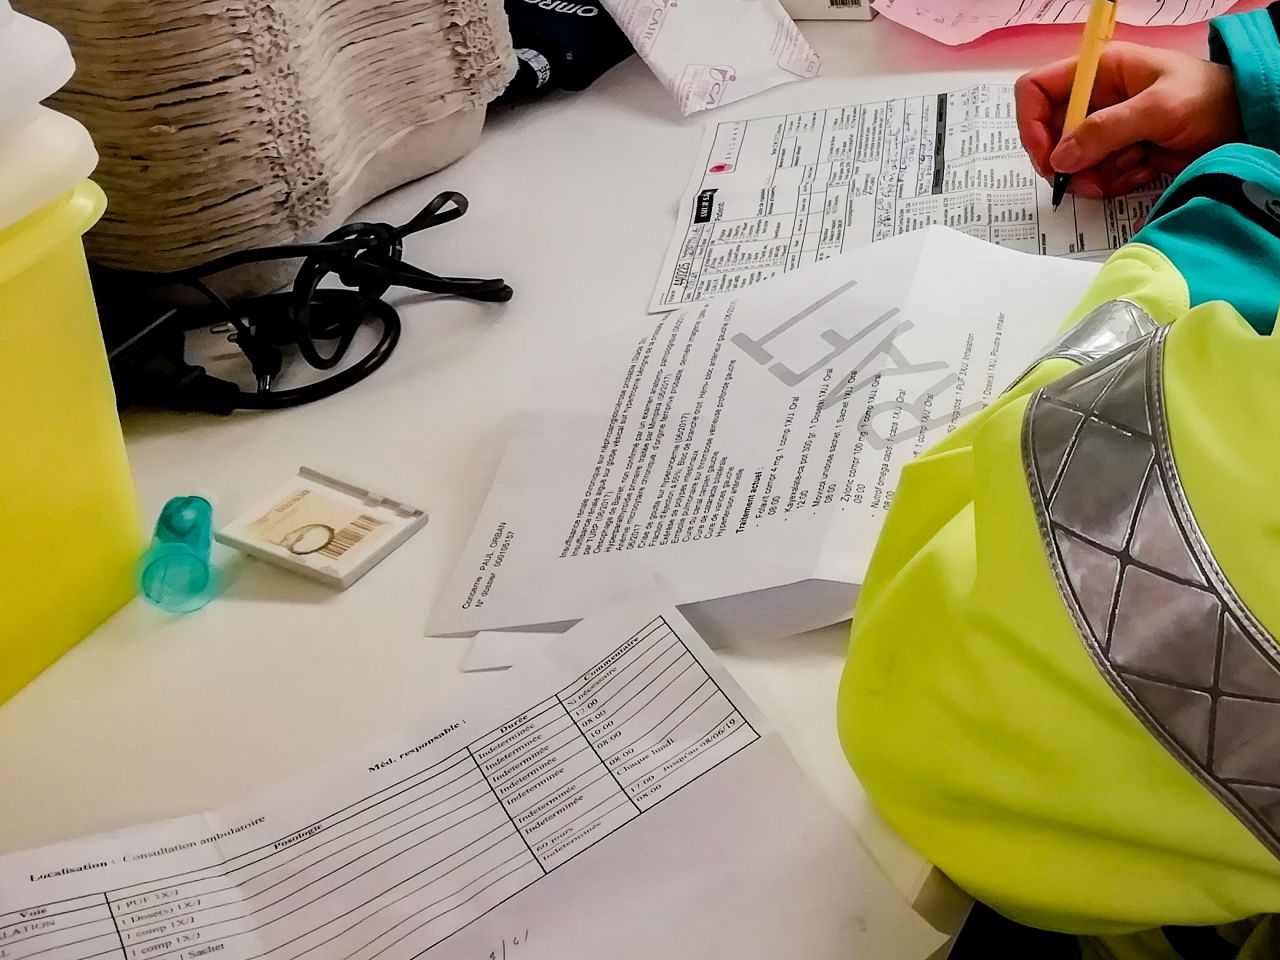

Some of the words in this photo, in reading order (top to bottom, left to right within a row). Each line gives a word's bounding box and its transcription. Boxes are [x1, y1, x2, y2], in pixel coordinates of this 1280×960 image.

[643, 8, 662, 40] CAIR
[963, 333, 974, 361] Inhalation
[990, 337, 1001, 356] Poudre
[730, 280, 988, 450] RAFT
[823, 368, 833, 382] Oral
[871, 373, 881, 387] Oral
[863, 405, 874, 422] comp
[802, 440, 812, 455] 300
[812, 480, 826, 507] Movicol
[822, 453, 834, 479] unidose
[837, 399, 849, 422] Sachet
[848, 370, 858, 384] Oral
[853, 442, 863, 455] 100
[870, 486, 882, 509] Nutrof
[877, 463, 889, 486] omega
[889, 421, 898, 438] caps
[896, 389, 906, 404] Oral
[671, 516, 686, 544] Embolie
[681, 482, 698, 516] pulmonaire
[693, 471, 701, 481] sur
[697, 437, 713, 470] thrombose
[709, 407, 721, 436] veineuse
[717, 382, 730, 408] profonde
[725, 359, 737, 381] gauche
[755, 495, 769, 519] Folavit
[764, 473, 776, 494] compr
[779, 427, 790, 446] comp
[789, 396, 800, 410] Oral
[800, 454, 808, 464] pot
[683, 450, 699, 482] intestinaux
[848, 454, 859, 478] compr
[674, 484, 687, 508] polypes
[704, 523, 716, 539] Cure
[711, 513, 719, 522] de
[715, 488, 727, 511] varices
[722, 466, 735, 489] gauche
[736, 492, 755, 534] Traitement
[750, 471, 762, 493] actuel
[840, 479, 854, 502] Zyloric
[671, 509, 678, 517] de
[716, 496, 734, 537] Hypertension
[479, 552, 494, 571] PAUL
[489, 522, 506, 548] ORBAN
[481, 572, 496, 597] dossier
[582, 635, 641, 680] Commentaire
[567, 695, 577, 706] Si
[575, 667, 617, 700] nécessaire
[498, 712, 527, 733] Durée
[368, 757, 396, 773] Méd.
[399, 723, 459, 759] responsable
[615, 750, 649, 776] Chaque
[272, 821, 324, 850] Posologie
[551, 828, 573, 843] jours
[30, 861, 107, 882] Localisation
[123, 841, 196, 861] Consultation
[200, 816, 265, 844] ambulatoire
[19, 906, 47, 918] Voie
[0, 920, 101, 939] LATION
[135, 922, 166, 937] comp
[141, 941, 172, 954] comp
[188, 943, 224, 958] Sachet
